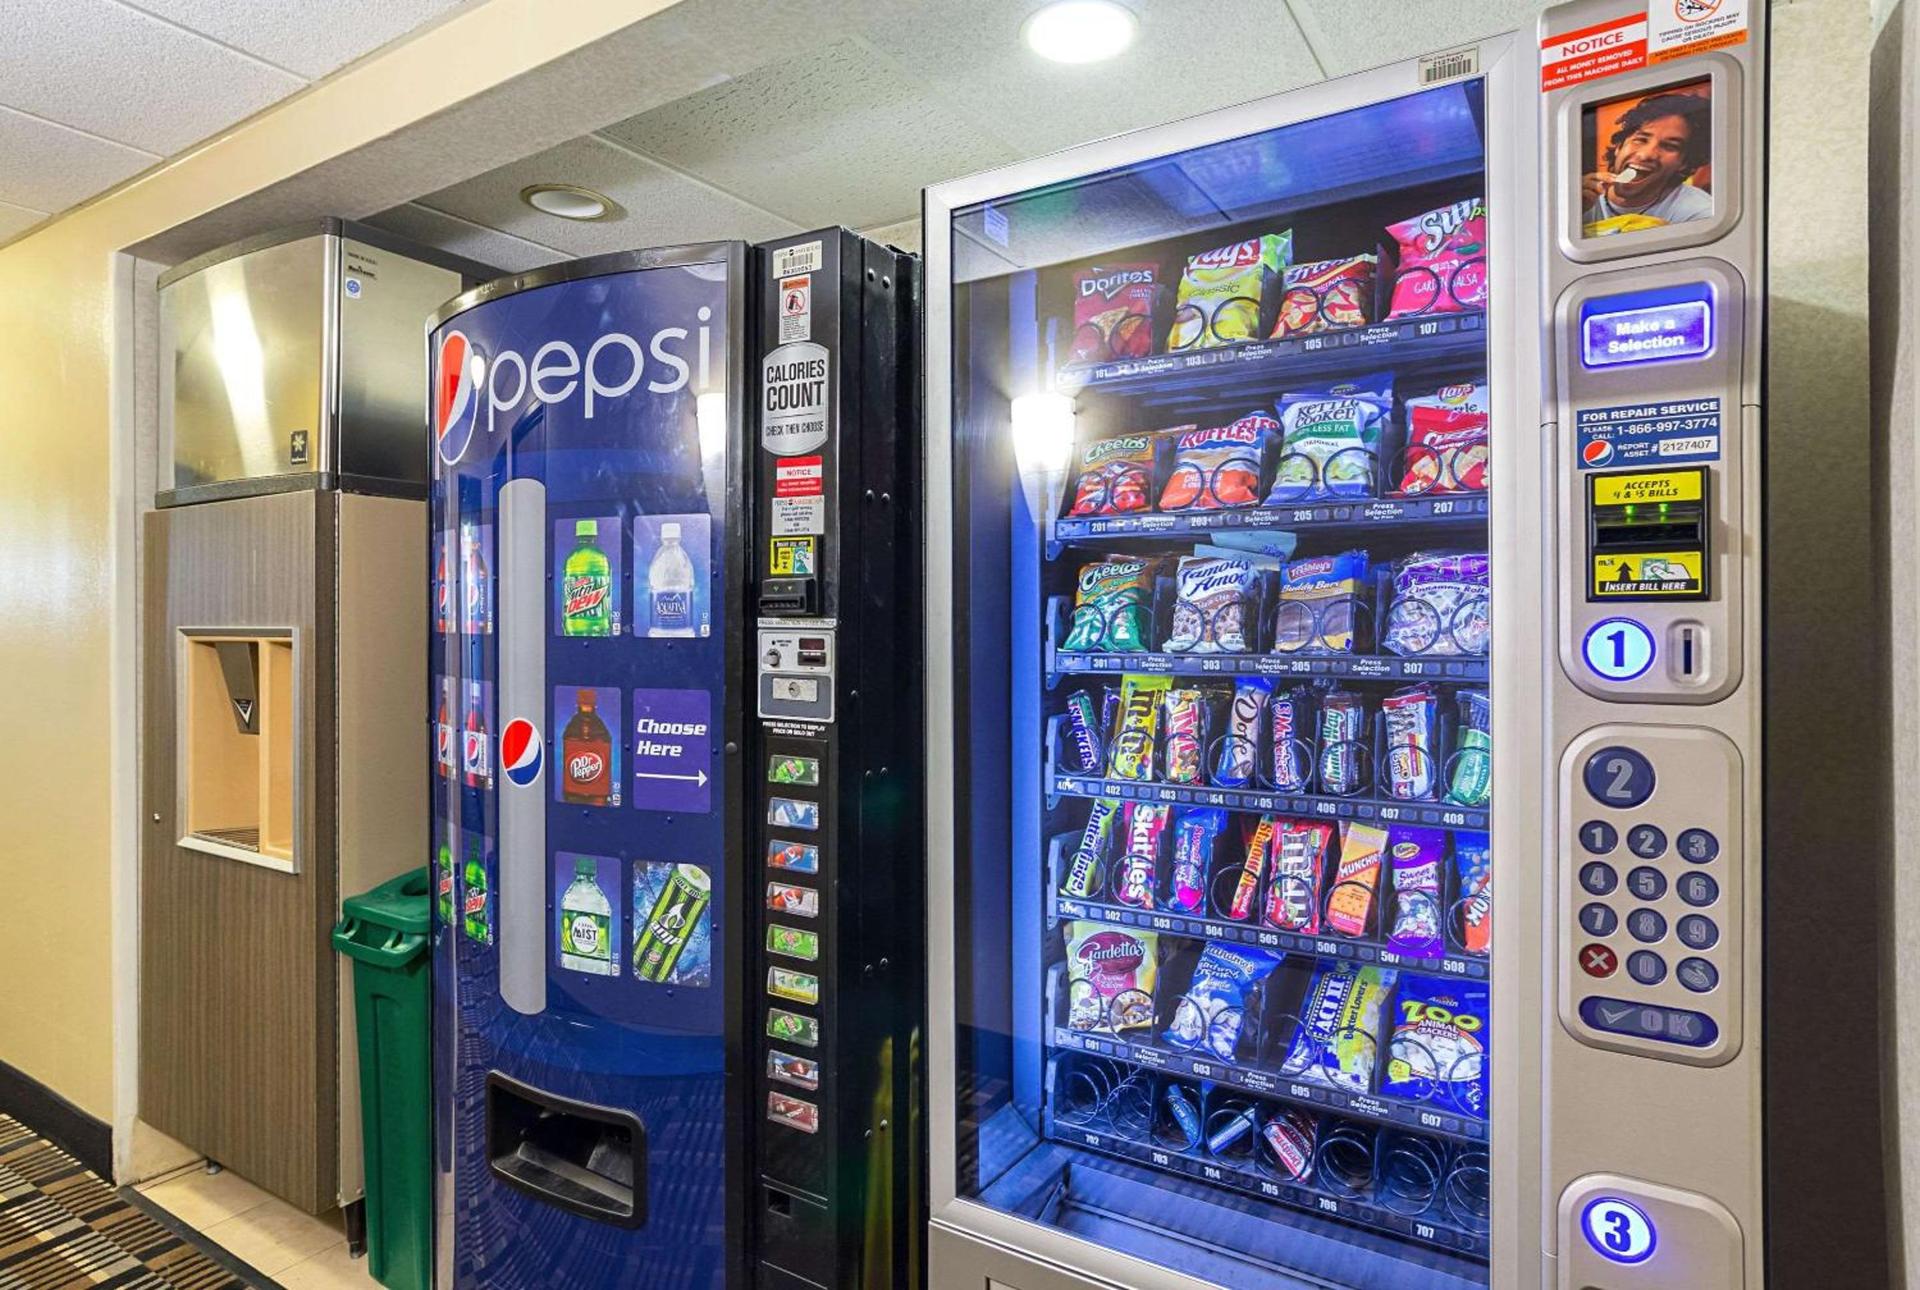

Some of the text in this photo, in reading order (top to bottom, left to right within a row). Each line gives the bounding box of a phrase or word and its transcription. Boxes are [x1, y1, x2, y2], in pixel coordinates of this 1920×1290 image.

[1563, 32, 1624, 56] NOTICE
[1557, 49, 1633, 74] ALL MONEY REMOVED
[1544, 56, 1644, 87] FROM THIS MACHINE DAILY
[1081, 270, 1153, 298] Doritos
[1420, 322, 1438, 335] 107
[1616, 319, 1676, 336] Make a
[1360, 331, 1398, 342] Selection
[1304, 340, 1322, 350] 105
[1607, 334, 1685, 354] Selection
[1186, 356, 1201, 366] 103
[488, 306, 712, 432] pepsi
[767, 359, 825, 384] CALORIES
[767, 380, 825, 412] COUNT
[1582, 401, 1718, 422] FOR REPAIR SERVICE
[1313, 424, 1350, 433] LESS FAT
[1583, 426, 1613, 434] PLEASE
[1617, 417, 1718, 436] 1-866-997-3774
[1180, 425, 1257, 449] RUFFLES
[1085, 437, 1150, 465] Cheetos
[1617, 442, 1650, 451] REPORT
[1663, 439, 1712, 452] 2127407
[1623, 449, 1650, 458] ASSET
[1624, 479, 1671, 490] ACCEPTS
[1623, 490, 1632, 499] &
[1648, 487, 1679, 498] BILLS
[1364, 507, 1404, 517] Selection
[1433, 502, 1453, 514] 207
[1245, 514, 1280, 523] Selection
[1294, 510, 1312, 521] 205
[1092, 522, 1106, 532] 201
[1081, 561, 1146, 591] Cheetos
[1181, 559, 1250, 586] Famous
[1186, 572, 1249, 597] Amos
[1605, 581, 1687, 593] INSERT BILL HERE
[1607, 630, 1625, 668] 1
[1093, 658, 1108, 668] 301
[1203, 660, 1221, 671] 303
[1292, 661, 1311, 672] 305
[1352, 664, 1391, 672] Selection
[1404, 662, 1424, 674] 307
[637, 718, 708, 736] Choose
[1068, 702, 1096, 770] SNICKERS
[636, 740, 683, 758] Here
[580, 755, 593, 767] Dr
[572, 757, 602, 779] Pepper
[1606, 758, 1633, 798] 2
[1105, 785, 1121, 796] 402
[1160, 790, 1177, 800] 403
[1316, 803, 1336, 814] 406
[1380, 808, 1400, 820] 407
[1443, 813, 1465, 825] 408
[1591, 827, 1707, 858] 1 2 3
[1128, 803, 1155, 899] Skittles
[1589, 867, 1707, 901] 4 5 6
[1105, 911, 1121, 922] 502
[1154, 918, 1171, 929] 503
[1591, 909, 1707, 943] 7 8 9
[572, 925, 598, 941] MIST
[1206, 926, 1223, 937] 504
[1259, 933, 1279, 946] 505
[1317, 942, 1337, 954] 506
[1076, 940, 1146, 976] Gardetto's
[1381, 951, 1400, 964] 507
[1443, 961, 1466, 974] 508
[1639, 956, 1656, 979] 0
[1401, 1000, 1482, 1032] ZOO
[1417, 1019, 1459, 1034] ANIMAL
[1640, 1009, 1693, 1038] OK
[1417, 1027, 1459, 1040] CRACKERS
[1291, 1085, 1310, 1098] 605
[1351, 1100, 1389, 1114] Selection
[1421, 1113, 1441, 1127] 607
[1085, 1133, 1100, 1146] 702
[1153, 1152, 1169, 1165] 703
[1204, 1166, 1221, 1179] 704
[1261, 1182, 1279, 1196] 705
[1319, 1198, 1337, 1212] 706
[1415, 1224, 1435, 1239] 707
[1605, 1210, 1631, 1252] 3
